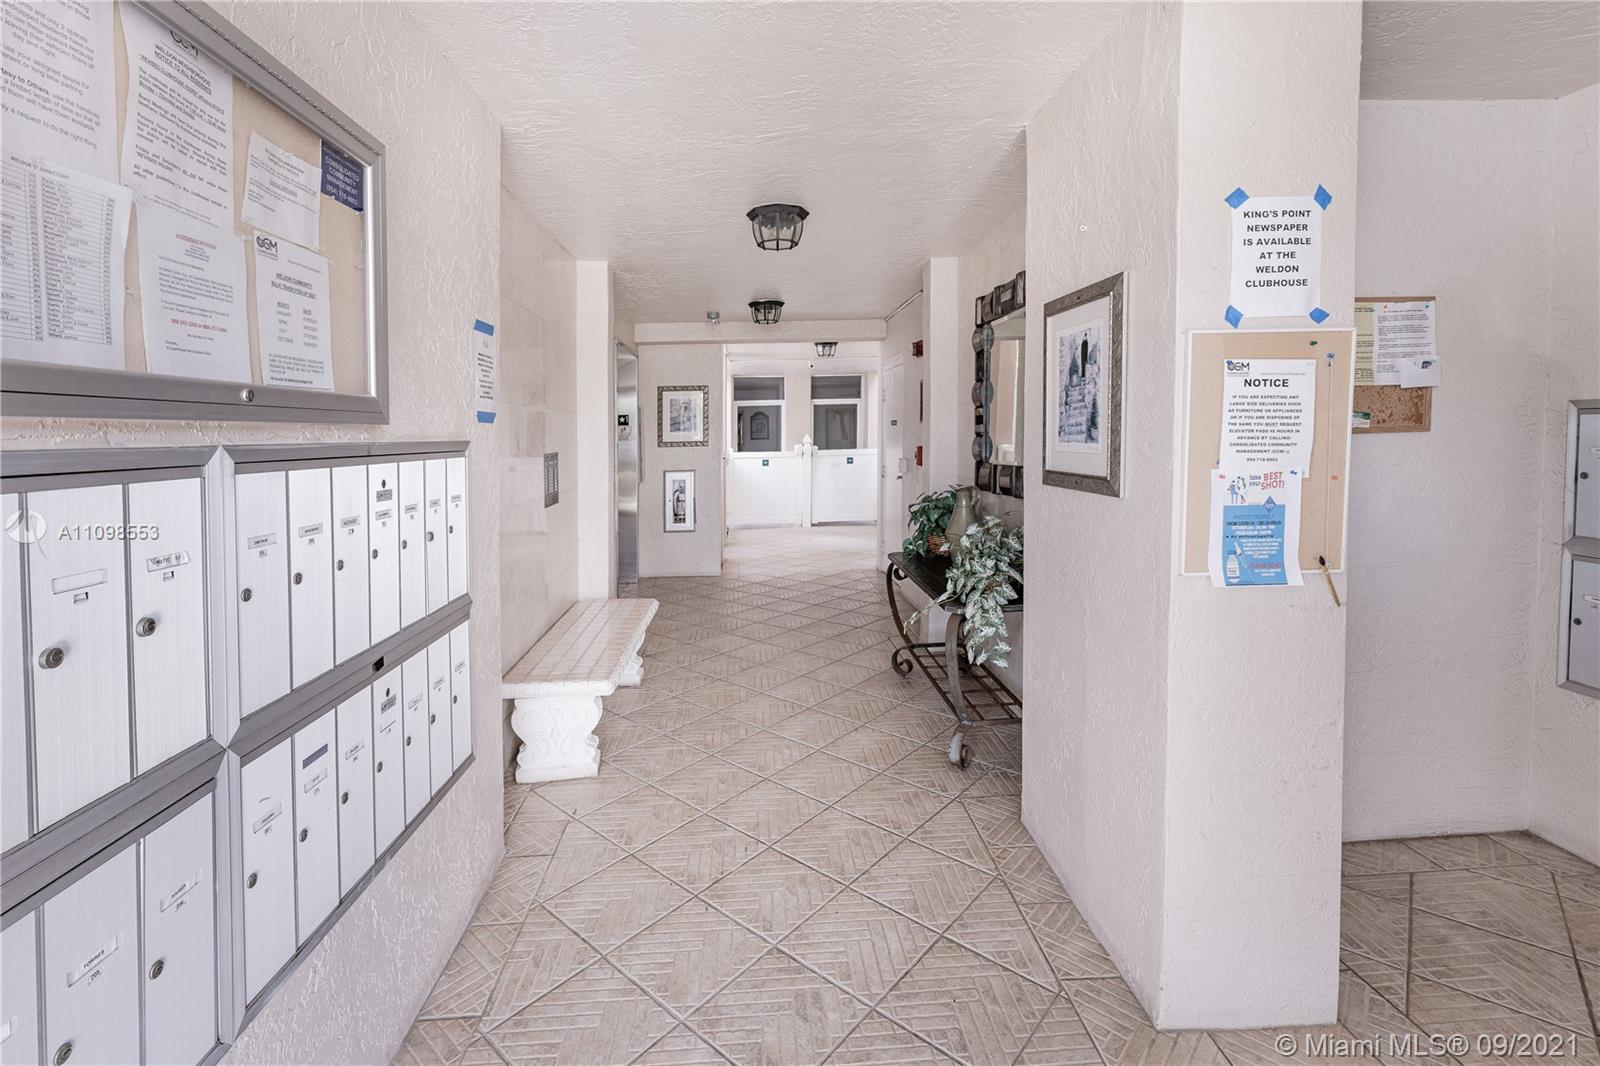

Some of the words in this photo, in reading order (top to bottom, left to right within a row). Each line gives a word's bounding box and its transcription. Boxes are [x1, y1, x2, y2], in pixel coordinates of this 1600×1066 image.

[1243, 210, 1278, 219] KING'S
[1282, 210, 1312, 218] POINT
[1246, 224, 1308, 232] NEWSPAPER
[1256, 237, 1312, 246] AVAILABLE
[1260, 252, 1273, 260] AT
[1276, 251, 1296, 259] THE
[1256, 265, 1300, 274] WELDON
[1245, 278, 1308, 288] CLUBHOUSE
[1244, 378, 1289, 388] NOTICE
[1264, 472, 1283, 480] BEST
[1261, 481, 1284, 490] SHOT!
